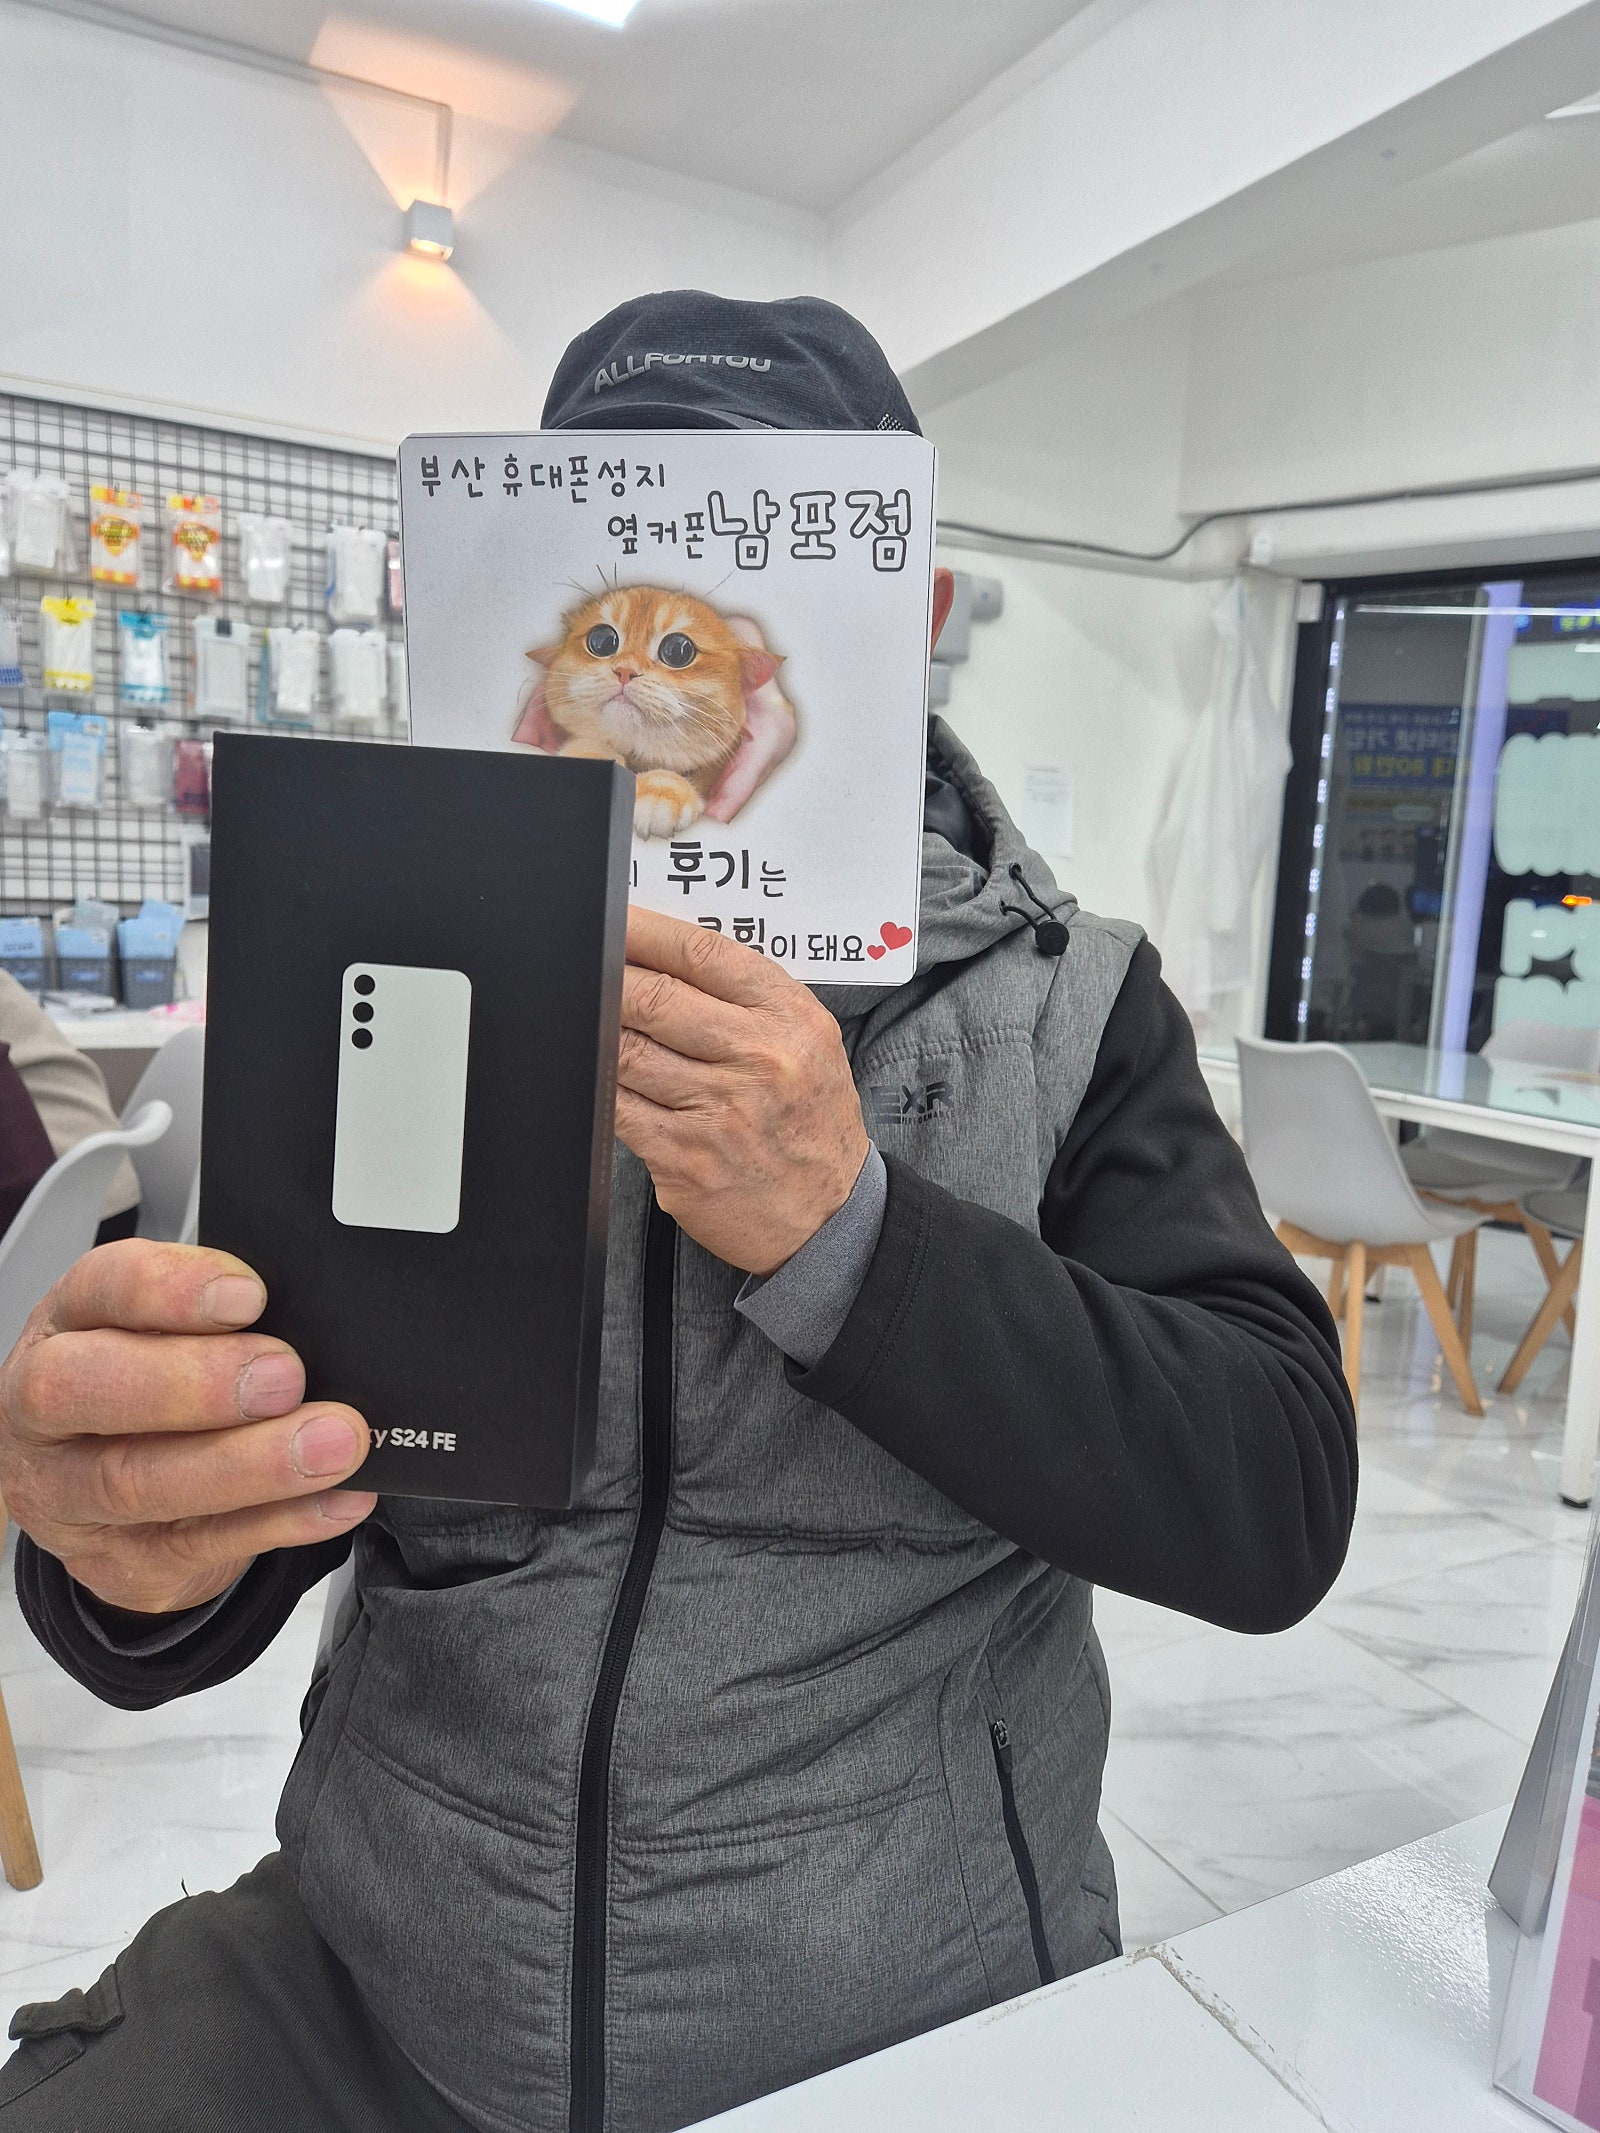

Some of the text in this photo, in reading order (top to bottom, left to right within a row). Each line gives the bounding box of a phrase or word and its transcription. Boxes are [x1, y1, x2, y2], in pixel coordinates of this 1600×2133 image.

[421, 455, 486, 498] 부산
[706, 488, 911, 573] 남포점
[667, 841, 787, 898] 후기는
[807, 934, 866, 962] 돼요
[389, 1427, 430, 1449] S24
[432, 1431, 457, 1452] FE
